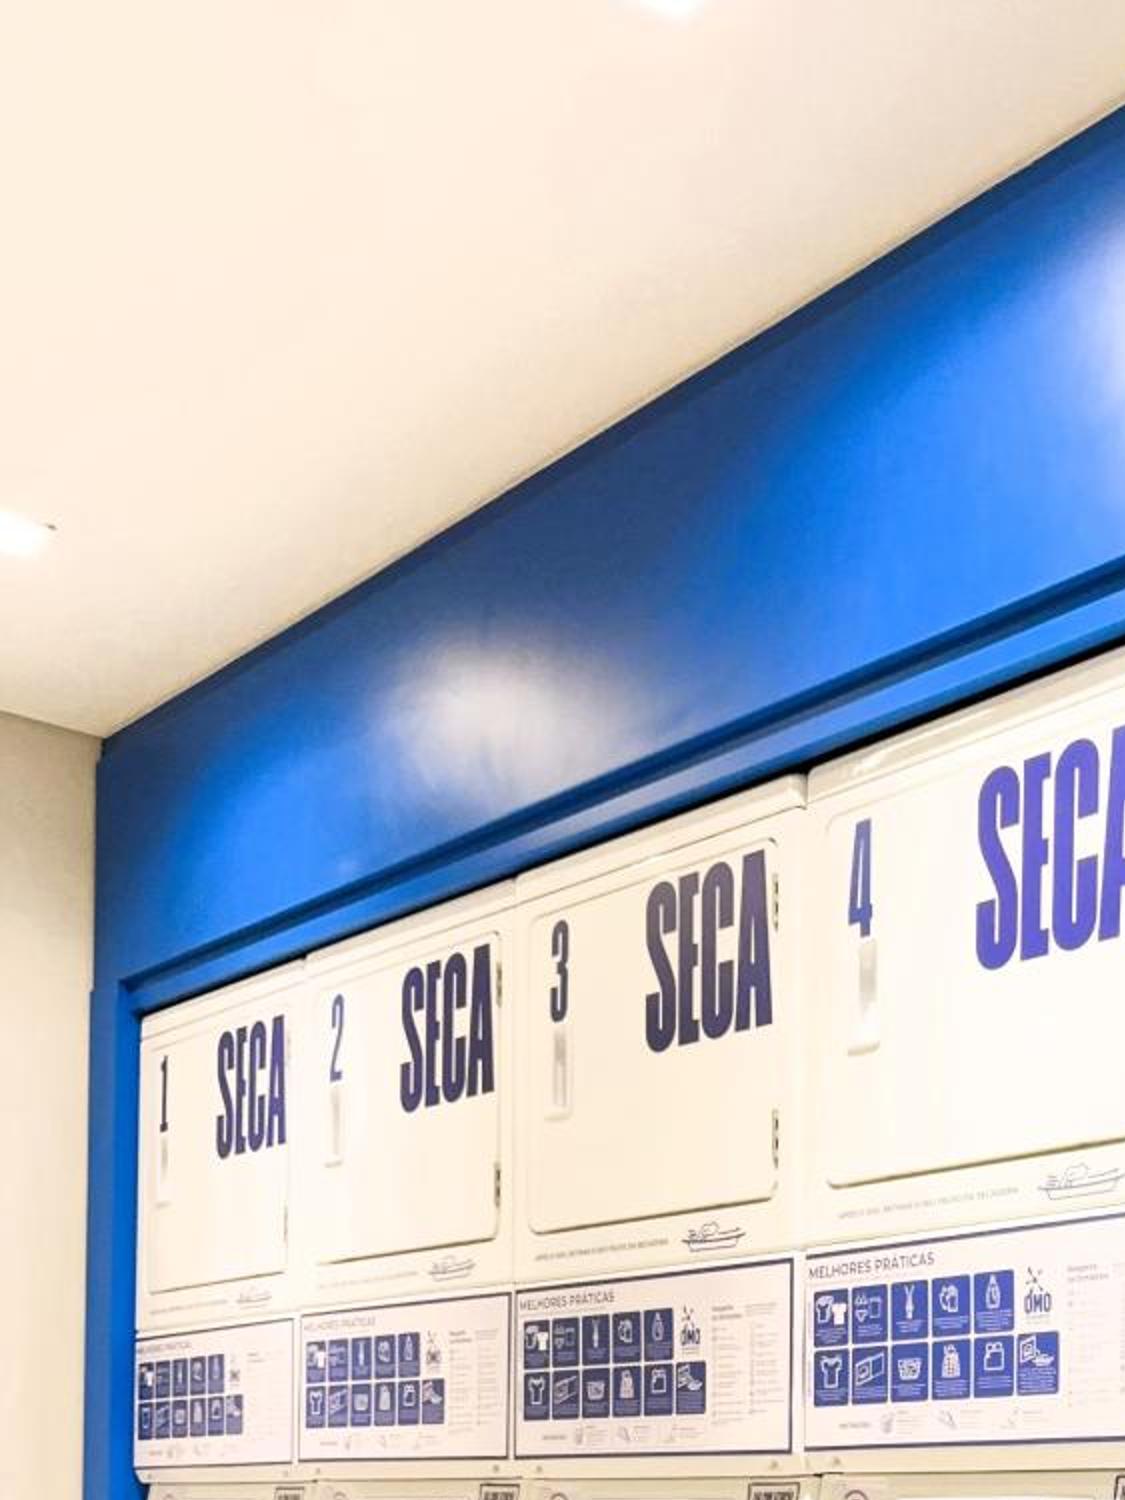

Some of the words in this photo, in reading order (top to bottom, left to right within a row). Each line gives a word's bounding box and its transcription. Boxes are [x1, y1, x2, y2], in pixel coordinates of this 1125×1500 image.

[848, 818, 872, 938] 4
[550, 920, 569, 1022] 3
[645, 849, 773, 1053] SECA
[329, 994, 345, 1082] 2
[400, 943, 495, 1113] SECA
[160, 1055, 168, 1132] 1
[215, 1014, 286, 1159] SECA
[809, 1257, 872, 1279] MELHORES
[1024, 1292, 1052, 1314] OMO
